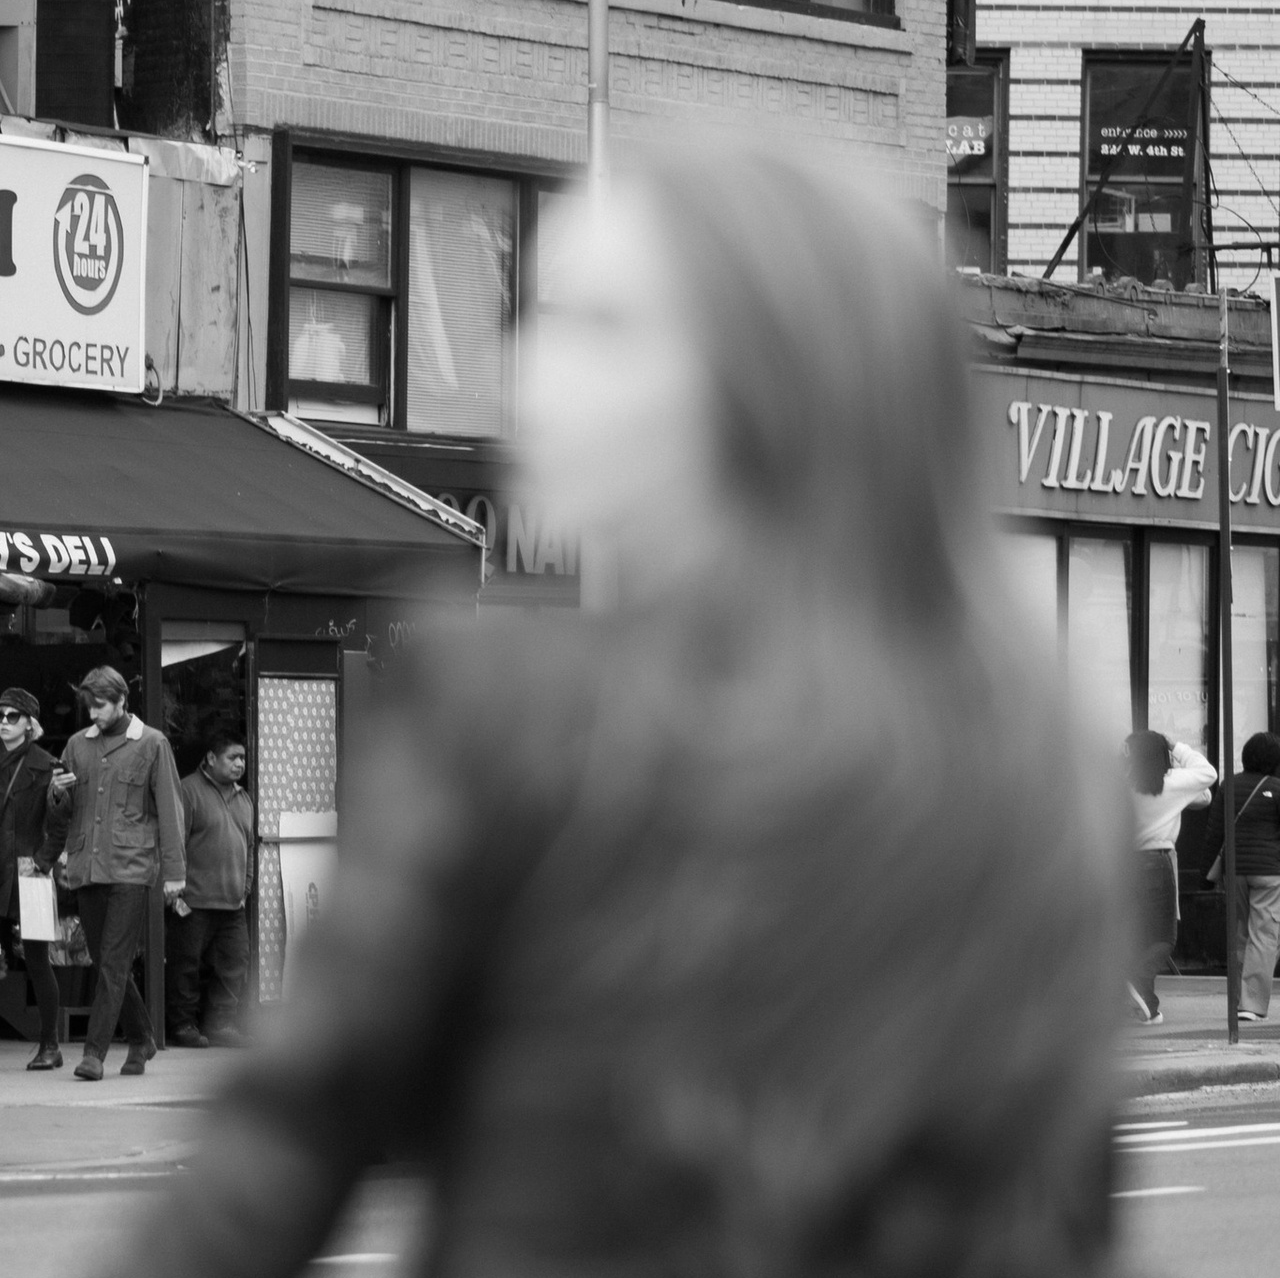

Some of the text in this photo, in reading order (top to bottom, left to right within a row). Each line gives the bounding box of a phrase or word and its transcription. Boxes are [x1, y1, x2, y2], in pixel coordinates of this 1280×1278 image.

[945, 140, 985, 155] LAB
[1101, 126, 1158, 138] entrnce
[1146, 145, 1168, 156] 4th
[73, 191, 106, 256] 24
[73, 253, 106, 279] hours
[13, 336, 130, 378] GROCERY
[1008, 401, 1211, 499] VILLAGE
[40, 534, 116, 575] DELI
